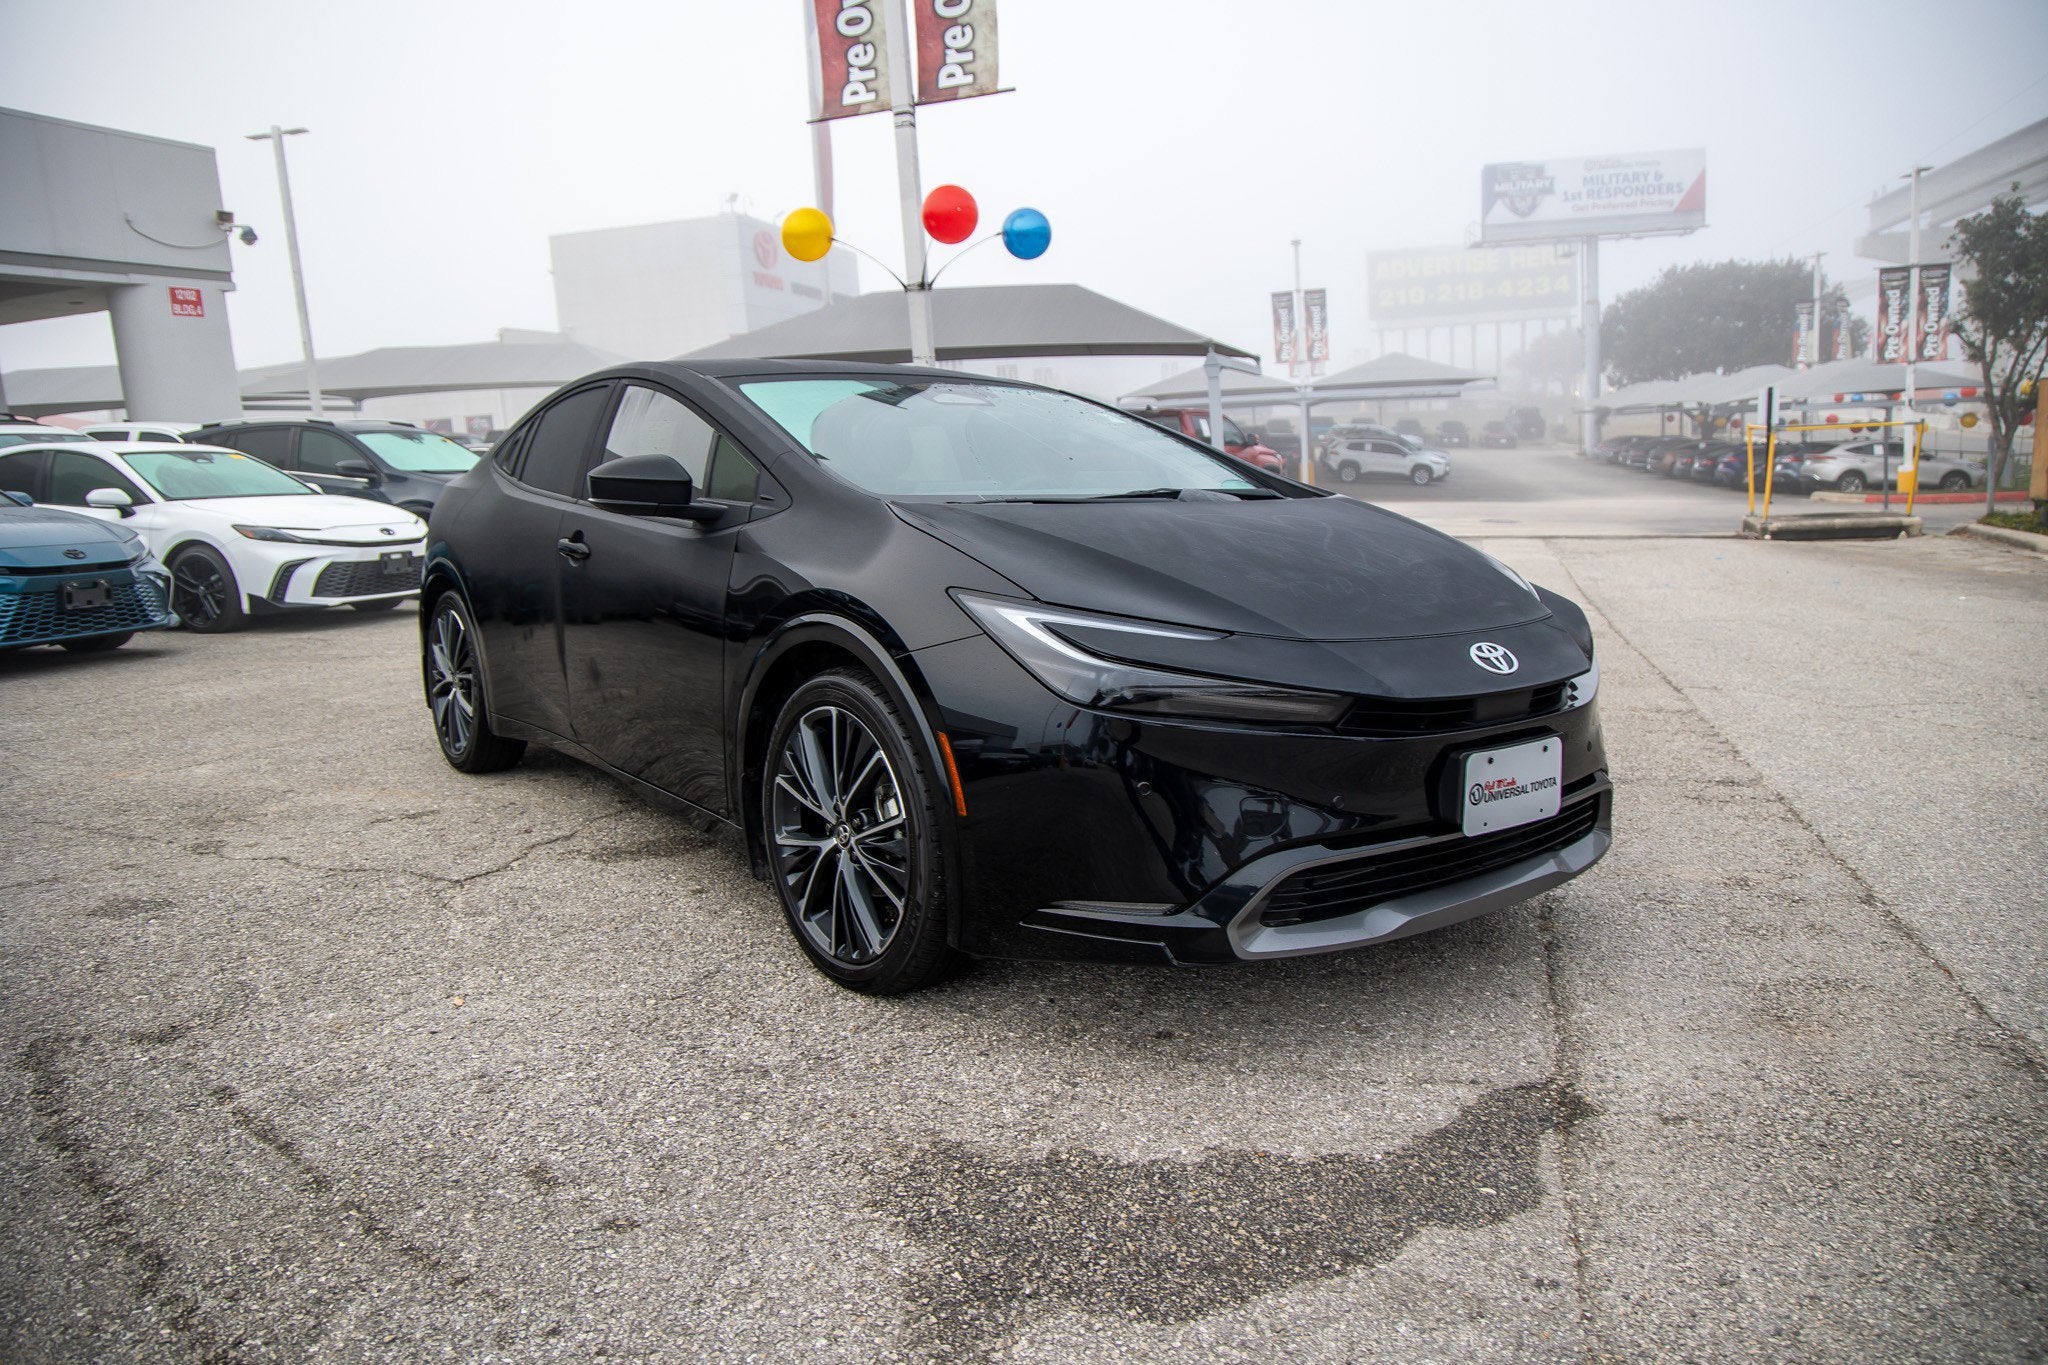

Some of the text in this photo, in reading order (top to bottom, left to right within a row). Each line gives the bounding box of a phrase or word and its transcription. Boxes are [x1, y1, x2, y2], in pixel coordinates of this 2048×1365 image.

[835, 0, 877, 107] Pre O
[937, 23, 976, 90] Pre
[1494, 177, 1552, 193] MILITARY
[1562, 189, 1583, 202] 1st
[1586, 182, 1685, 200] RESPONDERS
[1583, 170, 1664, 187] MILITARY &
[1376, 251, 1502, 279] ADVERTISE
[1310, 305, 1322, 340] Owned
[1885, 288, 1900, 335] Owned
[1924, 287, 1940, 332] Owned
[1278, 308, 1290, 343] Owned
[1884, 336, 1900, 360] Pre
[1923, 333, 1938, 357] Pre
[1483, 784, 1530, 803] UNIVERSAL
[1530, 776, 1558, 793] TOYOTA
